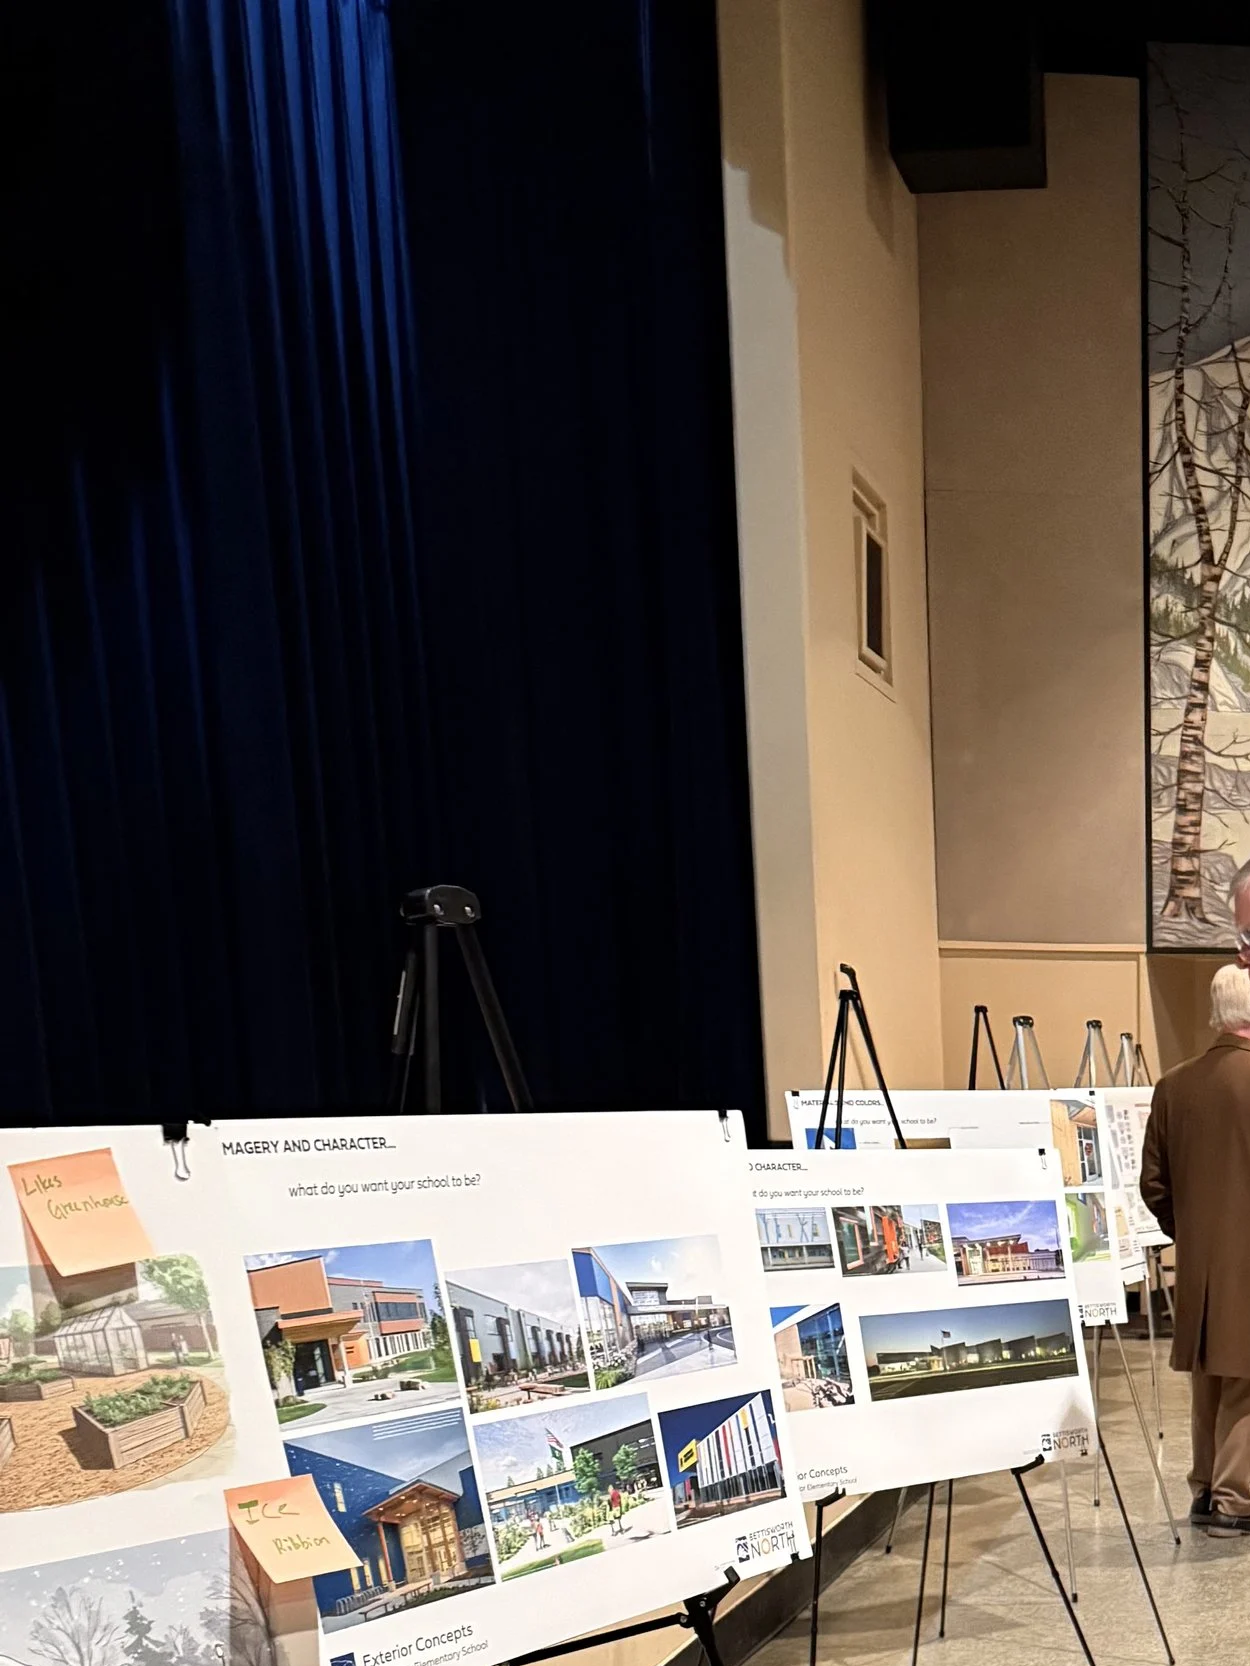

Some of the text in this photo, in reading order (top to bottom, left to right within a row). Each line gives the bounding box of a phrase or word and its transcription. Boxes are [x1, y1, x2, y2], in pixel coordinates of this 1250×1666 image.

[221, 1140, 279, 1155] MAGERY
[283, 1139, 311, 1153] AND
[288, 1173, 482, 1198] what do you want your school to be?
[769, 1190, 783, 1200] you
[784, 1188, 802, 1197] want
[803, 1189, 819, 1199] your
[820, 1187, 843, 1197] school
[1053, 1434, 1089, 1450] NORTH
[809, 1466, 848, 1479] Concepts
[750, 1530, 795, 1559] NORTH
[415, 1624, 474, 1653] Concepts
[462, 1640, 490, 1657] School
